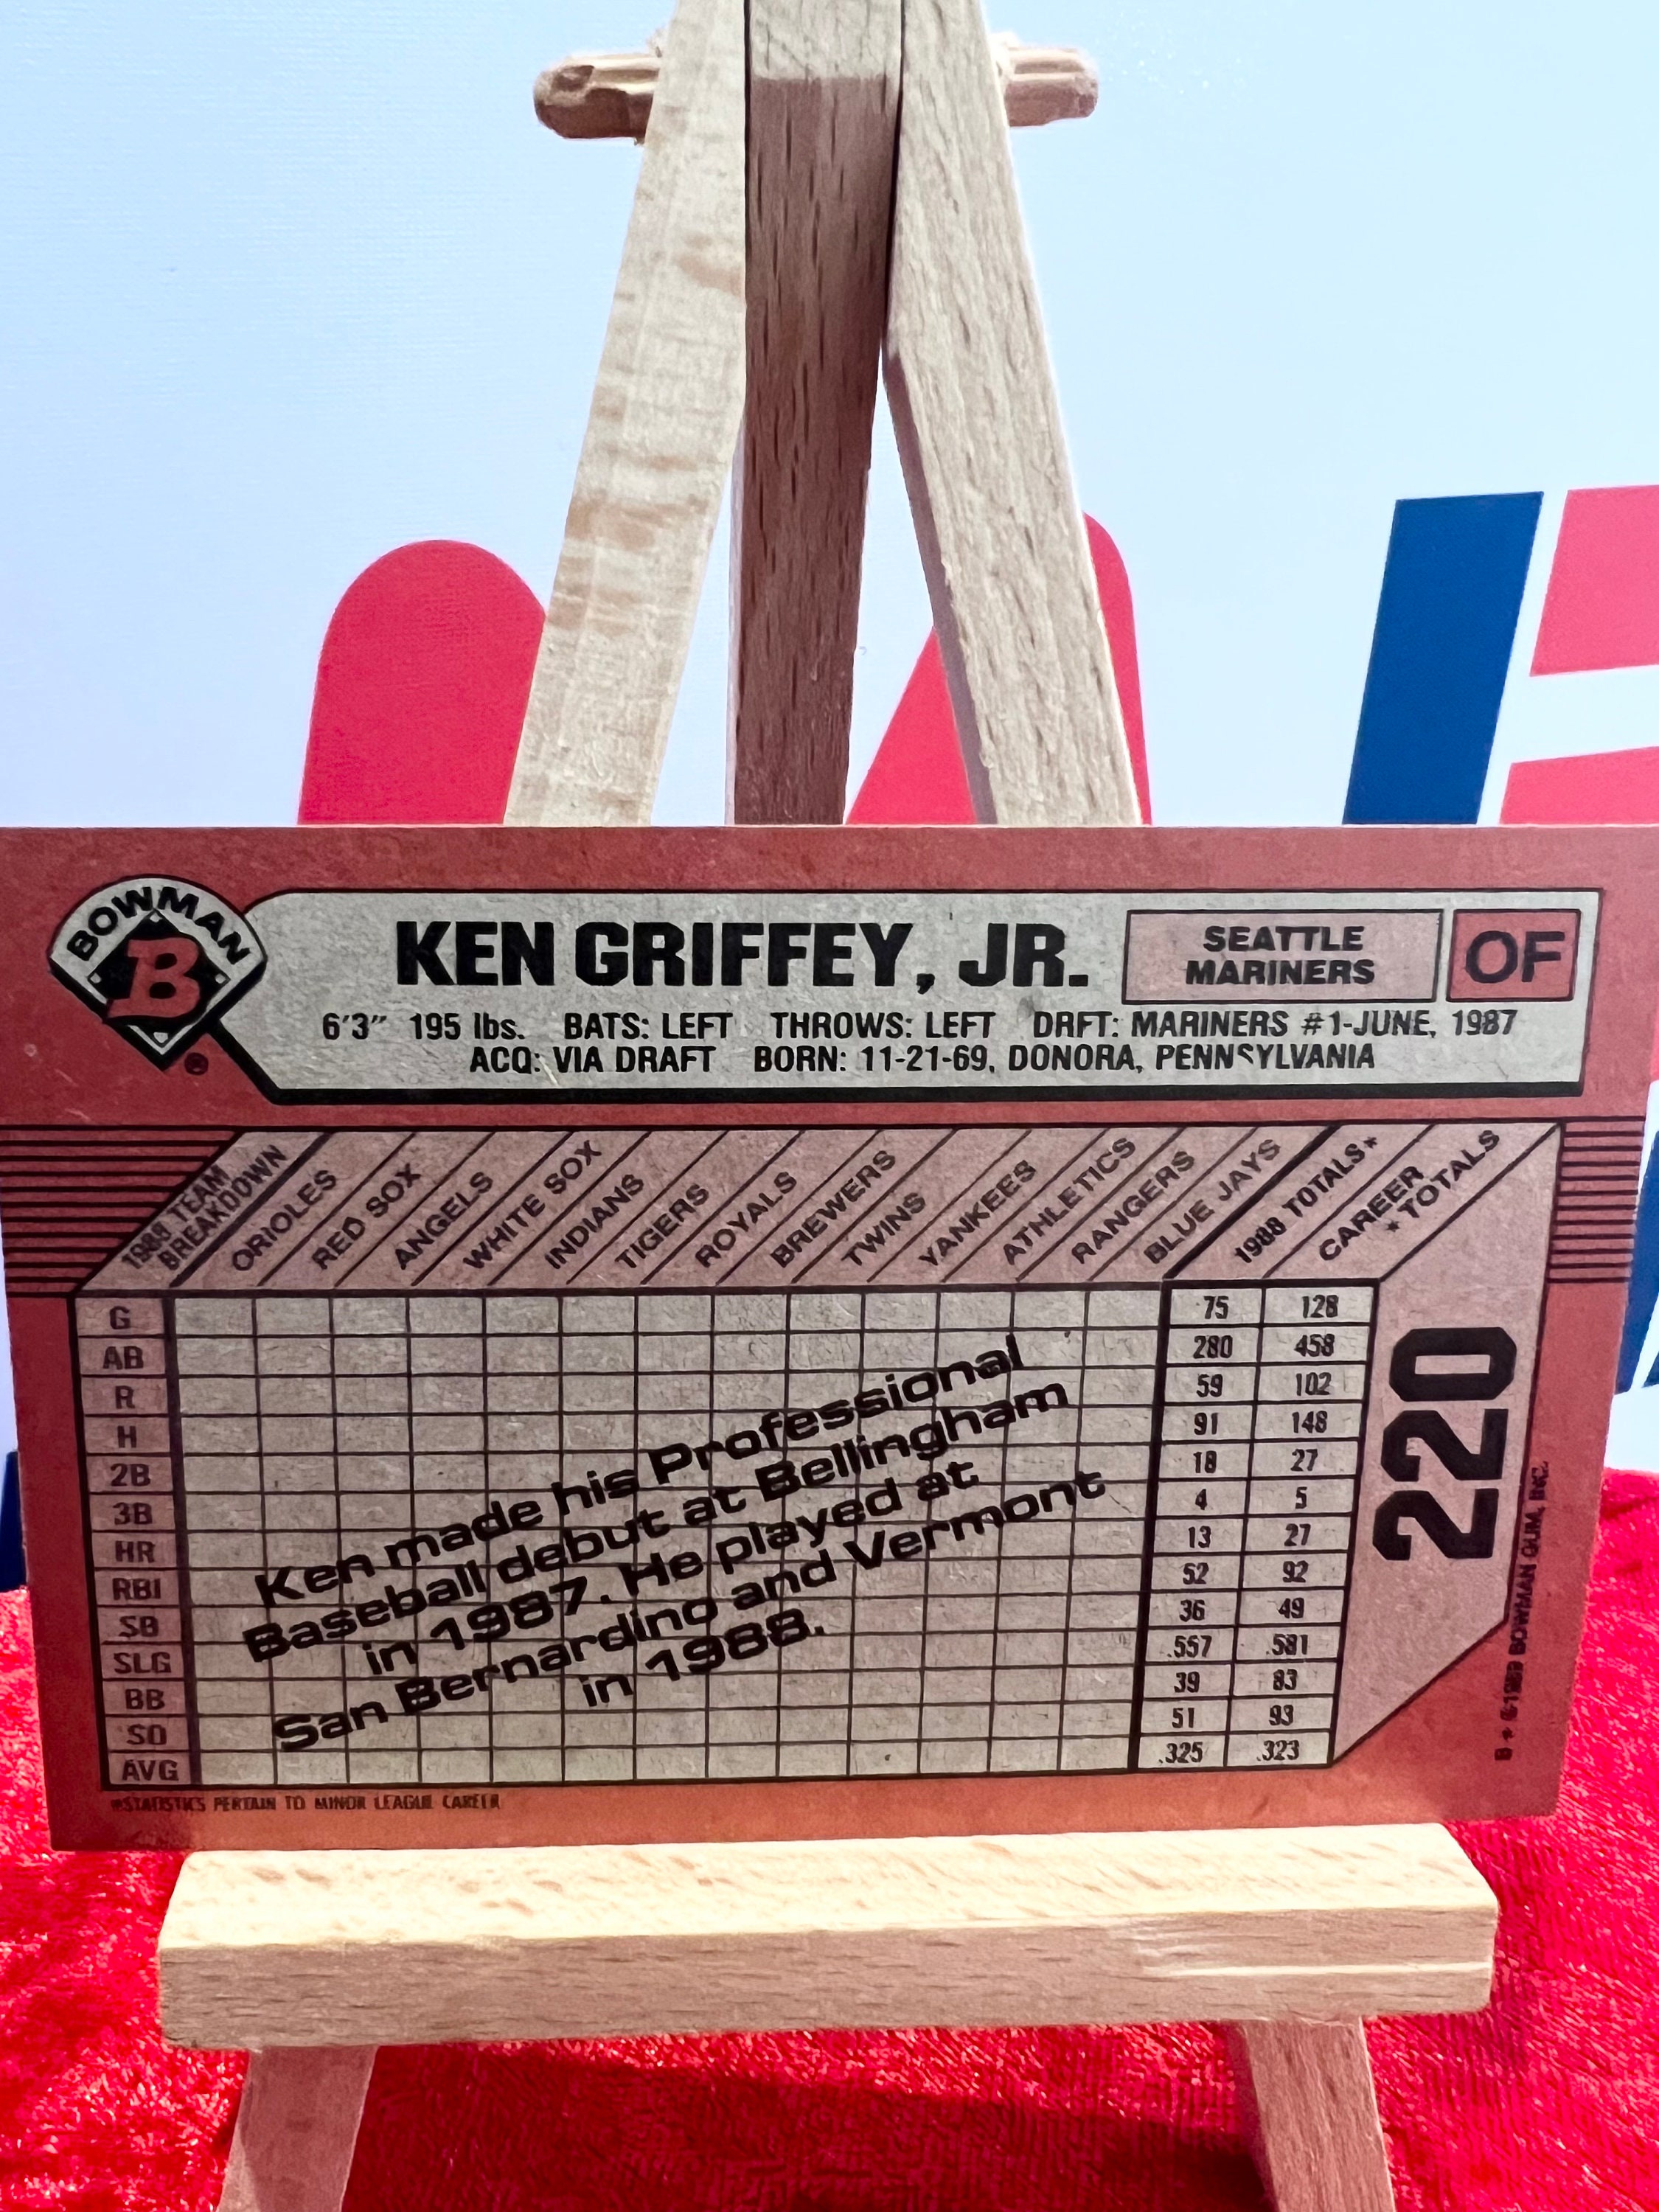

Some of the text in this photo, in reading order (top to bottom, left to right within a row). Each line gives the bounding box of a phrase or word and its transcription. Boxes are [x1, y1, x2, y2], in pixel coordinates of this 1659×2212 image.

[67, 886, 250, 964] BOWMAN
[1203, 926, 1365, 951] SEATTLE
[397, 921, 1088, 994] KEN GRIFFEY, JR.
[1464, 930, 1566, 984] OF
[107, 937, 201, 1018] B
[1185, 960, 1375, 985] MARINERS
[410, 1012, 461, 1040] 195
[474, 1012, 525, 1040] lbs.
[564, 1012, 649, 1039] BATS:
[662, 1012, 733, 1039] LEFT
[771, 1012, 912, 1038] THROWS:
[925, 1012, 996, 1038] LEFT
[1033, 1012, 1119, 1038] DRFT:
[1131, 1011, 1288, 1037] MARINERS
[1301, 1009, 1436, 1038] #1-JUNE,
[1453, 1009, 1518, 1035] 1987
[470, 1046, 540, 1074] ACQ:
[553, 1046, 603, 1072] VIA
[616, 1046, 717, 1072] DRAFT
[754, 1046, 846, 1072] BORN:
[861, 1045, 995, 1073] 11-21-69,
[1009, 1044, 1143, 1074] DONORA,
[167, 1165, 229, 1222] TEAM
[463, 1140, 602, 1269] WHITE SOX
[1003, 1138, 1136, 1265] ATHLETICS
[1142, 1139, 1281, 1264] BLUE JAYS
[157, 1144, 288, 1270] BREAKDOWN
[312, 1163, 421, 1270] RED SOX
[770, 1150, 896, 1267] BREWERS
[919, 1160, 1037, 1265] YANKEES
[1071, 1151, 1196, 1264] RANGERS
[1318, 1166, 1424, 1261] CAREER
[232, 1170, 337, 1271] ORIOLES
[394, 1172, 493, 1270] ANGELS
[545, 1174, 644, 1269] INDIANS
[615, 1184, 709, 1268] TIGERS
[695, 1172, 796, 1267] ROYALS
[841, 1192, 926, 1266] TWINS
[1234, 1217, 1286, 1264] 1988
[110, 1306, 131, 1329] G
[1203, 1295, 1228, 1319] 75
[1302, 1295, 1338, 1318] 128
[1193, 1335, 1233, 1359] 280
[1294, 1334, 1335, 1357] 458
[102, 1346, 144, 1370] AB
[1196, 1374, 1223, 1397] 59
[1295, 1372, 1332, 1396] 102
[116, 1385, 135, 1409] R
[1194, 1413, 1219, 1435] 91
[1292, 1411, 1328, 1433] 148
[117, 1425, 136, 1448] H
[1373, 1327, 1517, 1560] 220
[254, 1334, 1024, 1607] Ken made his Professional
[1193, 1450, 1217, 1473] 18
[1290, 1449, 1318, 1472] 27
[110, 1464, 150, 1487] 2B
[1195, 1489, 1207, 1510] 4
[1295, 1486, 1307, 1509] 5
[113, 1503, 153, 1525] 3B
[243, 1383, 1068, 1663] Baseball debut at Bellingham
[1189, 1526, 1211, 1548] 13
[1284, 1523, 1311, 1546] 27
[115, 1540, 155, 1563] HR
[362, 1461, 979, 1675] in 1987. He played at
[1183, 1562, 1209, 1585] 52
[1283, 1560, 1310, 1582] 92
[112, 1577, 161, 1600] RBI
[274, 1471, 1106, 1753] San Bernardino and Vermont
[1180, 1599, 1205, 1621] 36
[1279, 1598, 1304, 1618] 49
[1509, 1564, 1537, 1655] BOWMAN
[119, 1615, 159, 1638] SB
[1167, 1635, 1212, 1658] .557
[1266, 1634, 1308, 1655] .581
[114, 1652, 171, 1674] SLG
[578, 1608, 825, 1706] in 1988.
[1174, 1672, 1200, 1693] 39
[1273, 1669, 1298, 1690] 83
[125, 1689, 165, 1710] BB
[1172, 1708, 1194, 1728] 51
[1269, 1705, 1294, 1725] 93
[127, 1724, 167, 1745] SO
[1159, 1742, 1203, 1764] .325
[1256, 1740, 1299, 1761] .323
[122, 1759, 179, 1781] AVG
[214, 1797, 276, 1811] PERTAIN
[285, 1796, 306, 1810] TO
[314, 1795, 366, 1810] MINOR
[373, 1795, 433, 1810] LEAGUE
[442, 1794, 501, 1810] CAREER
